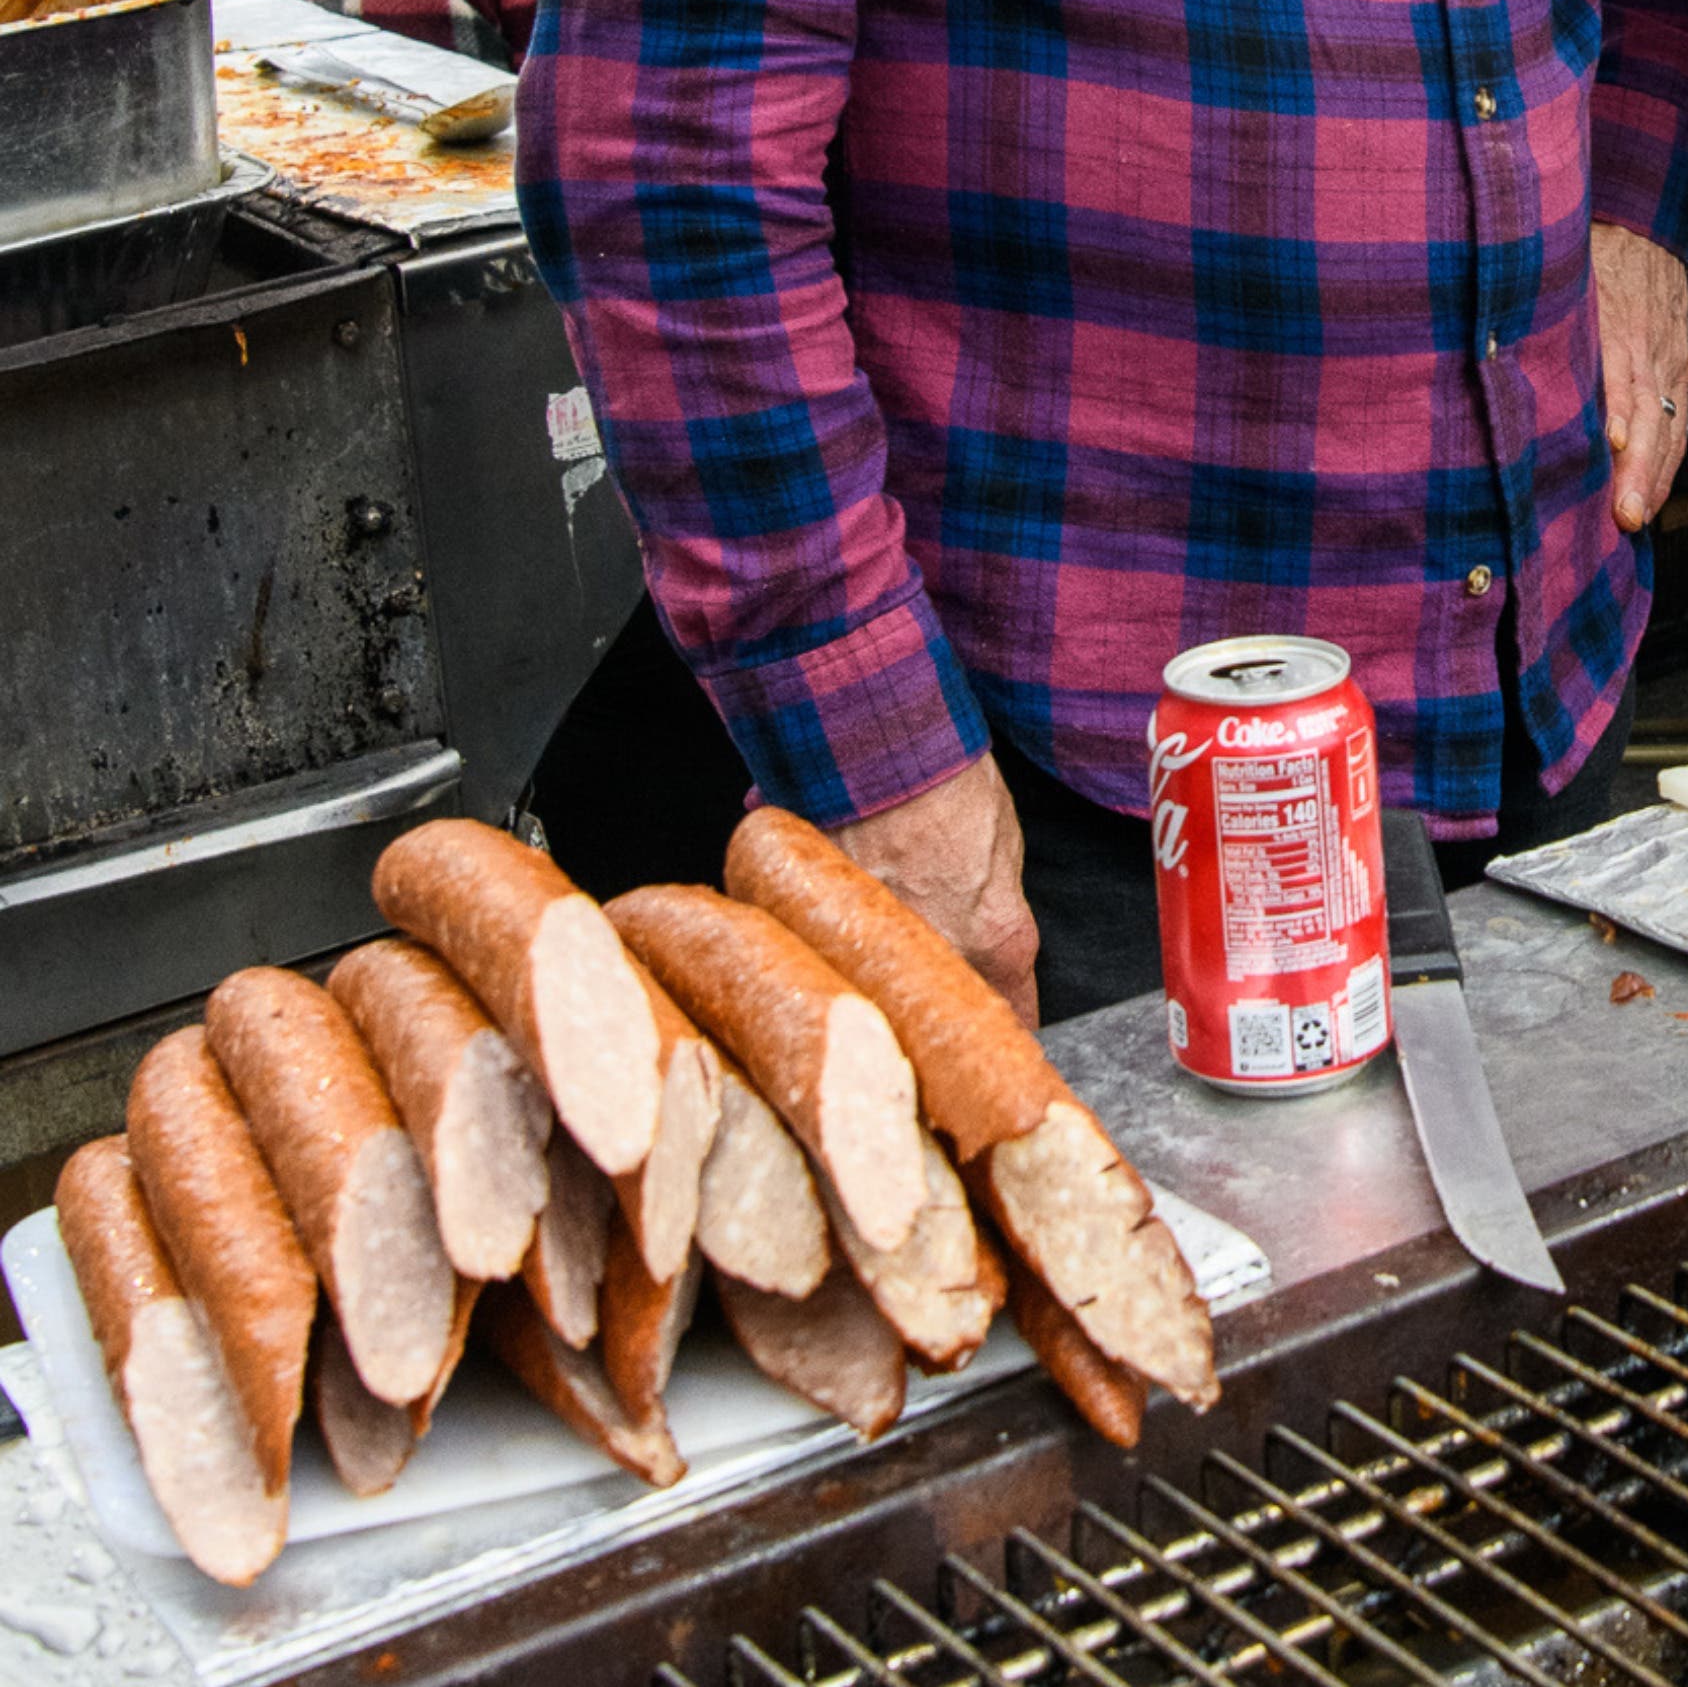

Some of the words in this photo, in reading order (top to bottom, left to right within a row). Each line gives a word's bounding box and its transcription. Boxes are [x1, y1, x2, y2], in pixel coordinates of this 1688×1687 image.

[1218, 762, 1276, 779] Nutrition
[1277, 758, 1315, 777] Facts
[1221, 812, 1279, 829] Calories
[1283, 799, 1316, 826] 140
